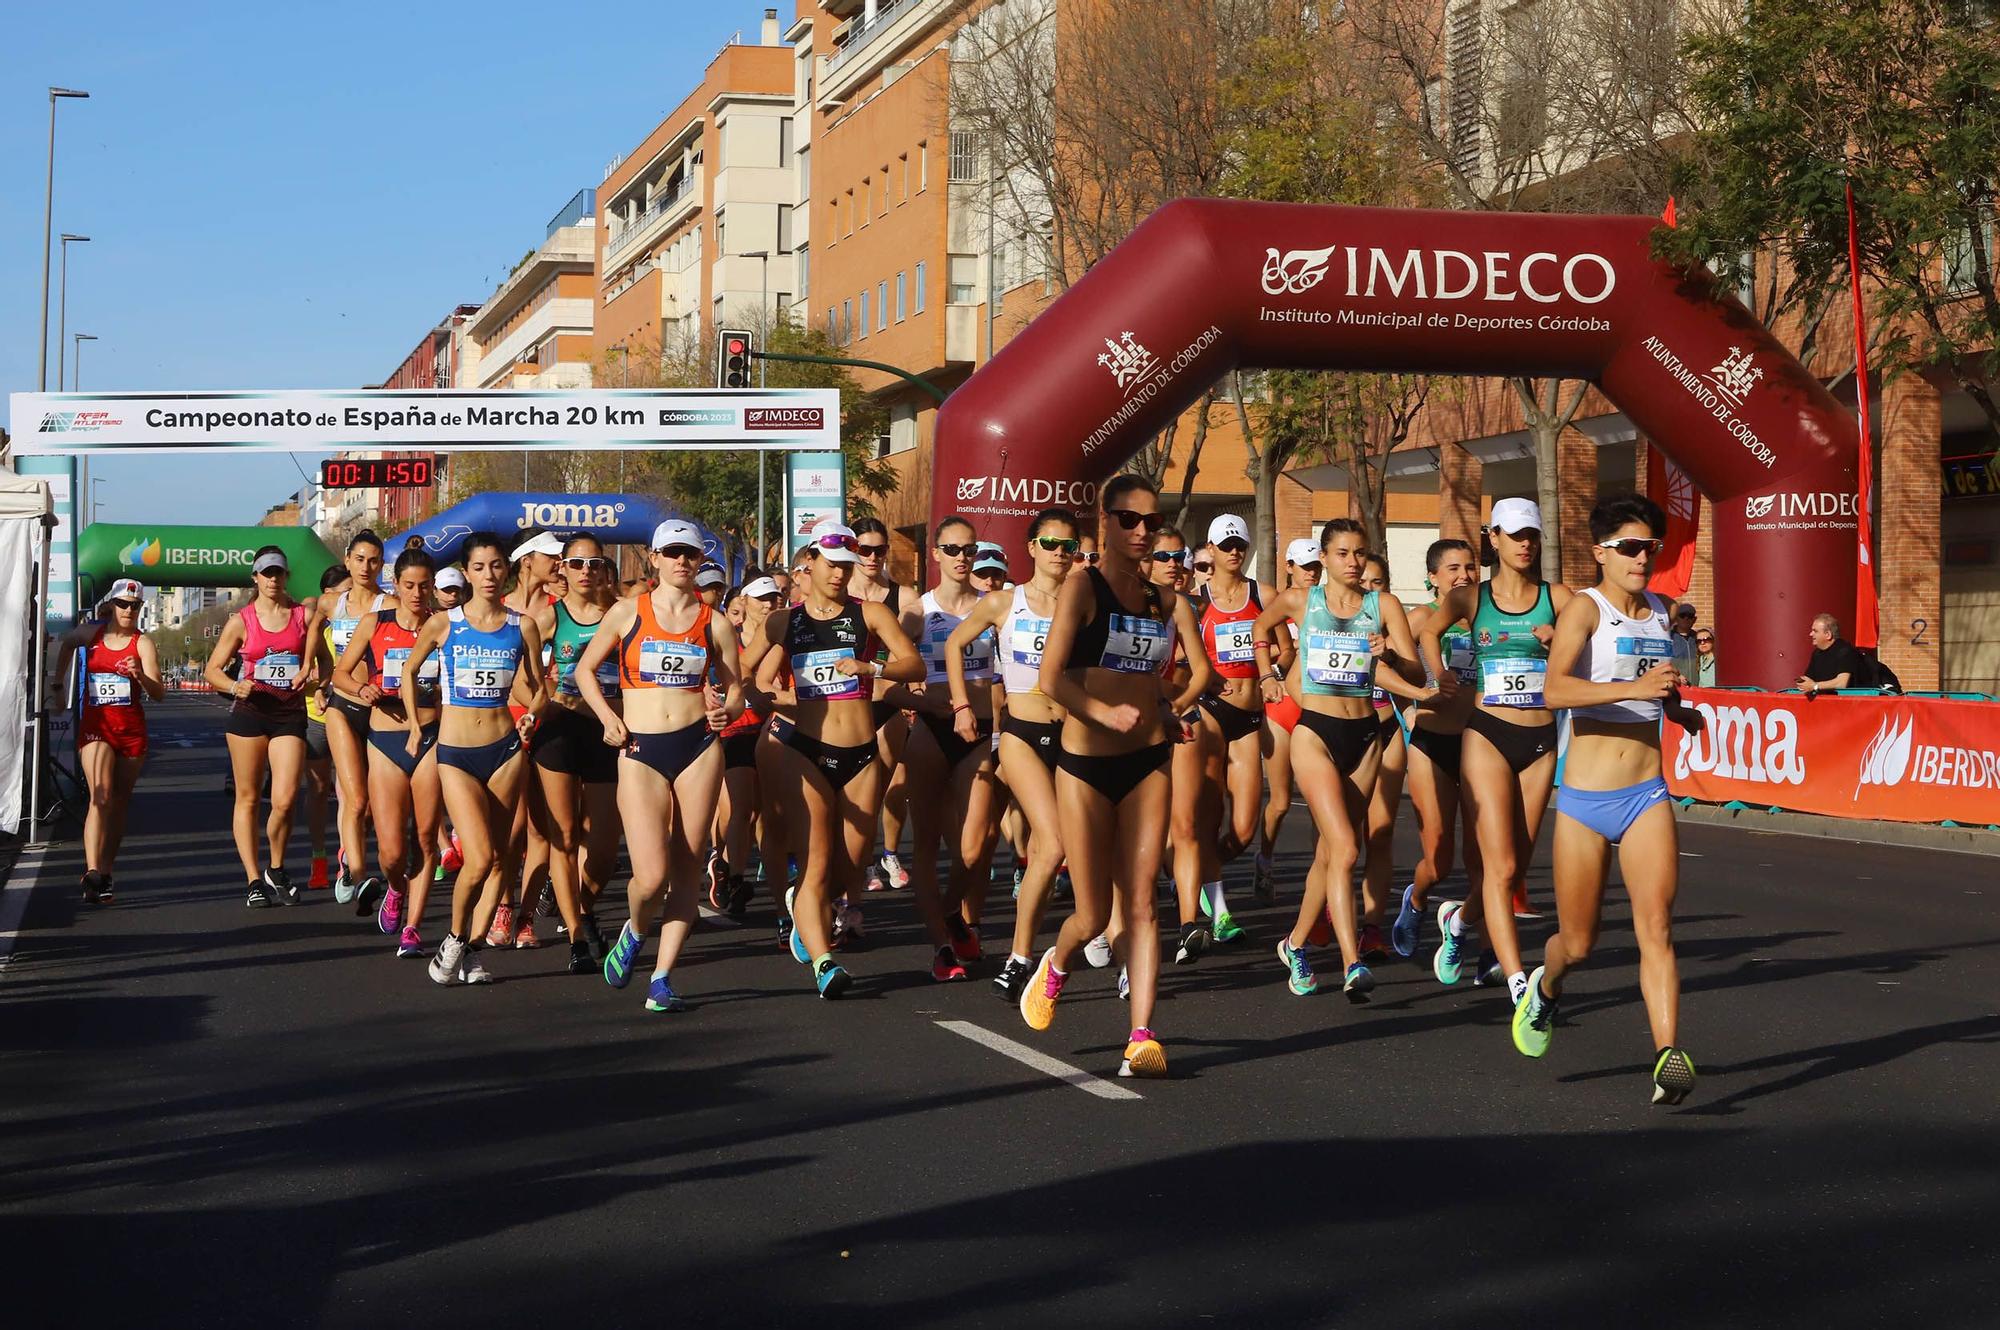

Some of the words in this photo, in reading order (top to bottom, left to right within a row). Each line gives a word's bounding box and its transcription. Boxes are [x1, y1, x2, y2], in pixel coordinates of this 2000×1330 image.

[1344, 246, 1617, 304] IMDECO
[1260, 306, 1332, 324] Instituto
[1336, 310, 1422, 330] Municipal
[1427, 312, 1449, 328] de
[1454, 313, 1533, 332] Deportes
[1538, 314, 1610, 331] Córdoba
[1081, 382, 1158, 457] AYUNTAMIENTO
[1155, 368, 1174, 388] DE
[1170, 325, 1223, 374] CÓRDOBA
[1641, 335, 1718, 409] AYUNTAMIENTO
[1712, 403, 1732, 424] DE
[1727, 418, 1777, 469] CÓRDOBA
[145, 408, 312, 431] Campeonato
[315, 413, 337, 427] de
[344, 405, 436, 431] España
[440, 412, 462, 426] de
[467, 406, 559, 426] Marcha
[566, 406, 598, 426] 20
[605, 405, 645, 425] km
[663, 412, 709, 422] CÓRDOBA
[765, 409, 820, 421] IMDECO
[327, 462, 427, 486] 00:11:50
[990, 476, 1096, 506] IMDECO
[956, 505, 986, 514] Instituto
[987, 506, 1028, 517] Municipal
[1029, 509, 1040, 517] de
[1746, 522, 1776, 530] Instituto
[1777, 521, 1817, 530] Municipal
[1818, 521, 1828, 529] de
[1318, 629, 1369, 639] universid
[1911, 618, 1929, 645] 2
[1033, 635, 1045, 652] 6
[1130, 636, 1153, 657] 57
[1233, 633, 1253, 648] 84
[661, 655, 685, 672] 62
[1228, 650, 1254, 660] Jom
[1329, 652, 1352, 669] 87
[269, 666, 286, 678] 78
[475, 671, 496, 686] 55
[814, 666, 835, 682] 67
[100, 684, 116, 696] 65
[1503, 674, 1526, 691] 56
[1910, 744, 2000, 790] IBERDR
